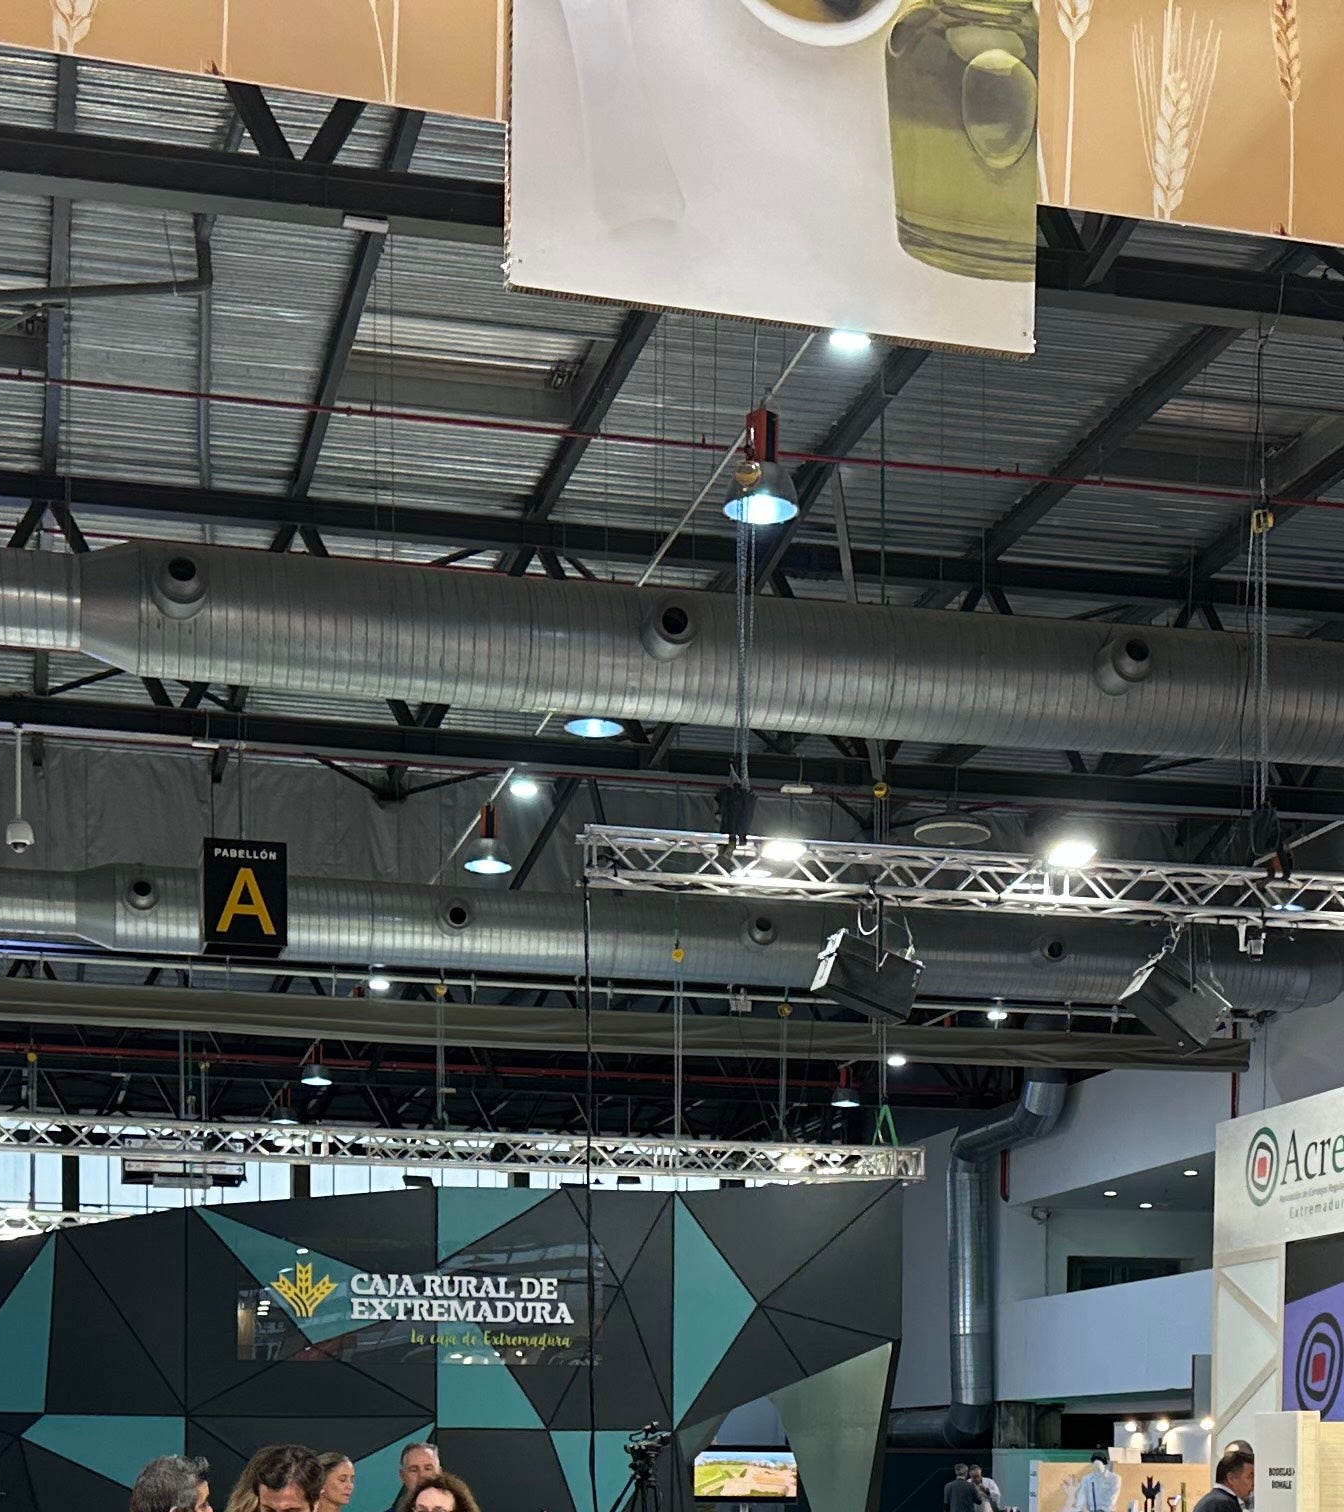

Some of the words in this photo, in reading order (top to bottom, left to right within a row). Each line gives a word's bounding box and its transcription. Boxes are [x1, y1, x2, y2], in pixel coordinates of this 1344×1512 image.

[214, 847, 277, 861] PABELLÓN
[216, 867, 277, 936] A
[350, 1274, 419, 1298] CAJA
[423, 1275, 516, 1299] RURAL
[520, 1277, 559, 1300] DE
[350, 1298, 575, 1324] EXTREMADURA
[483, 1331, 573, 1349] Extremadura
